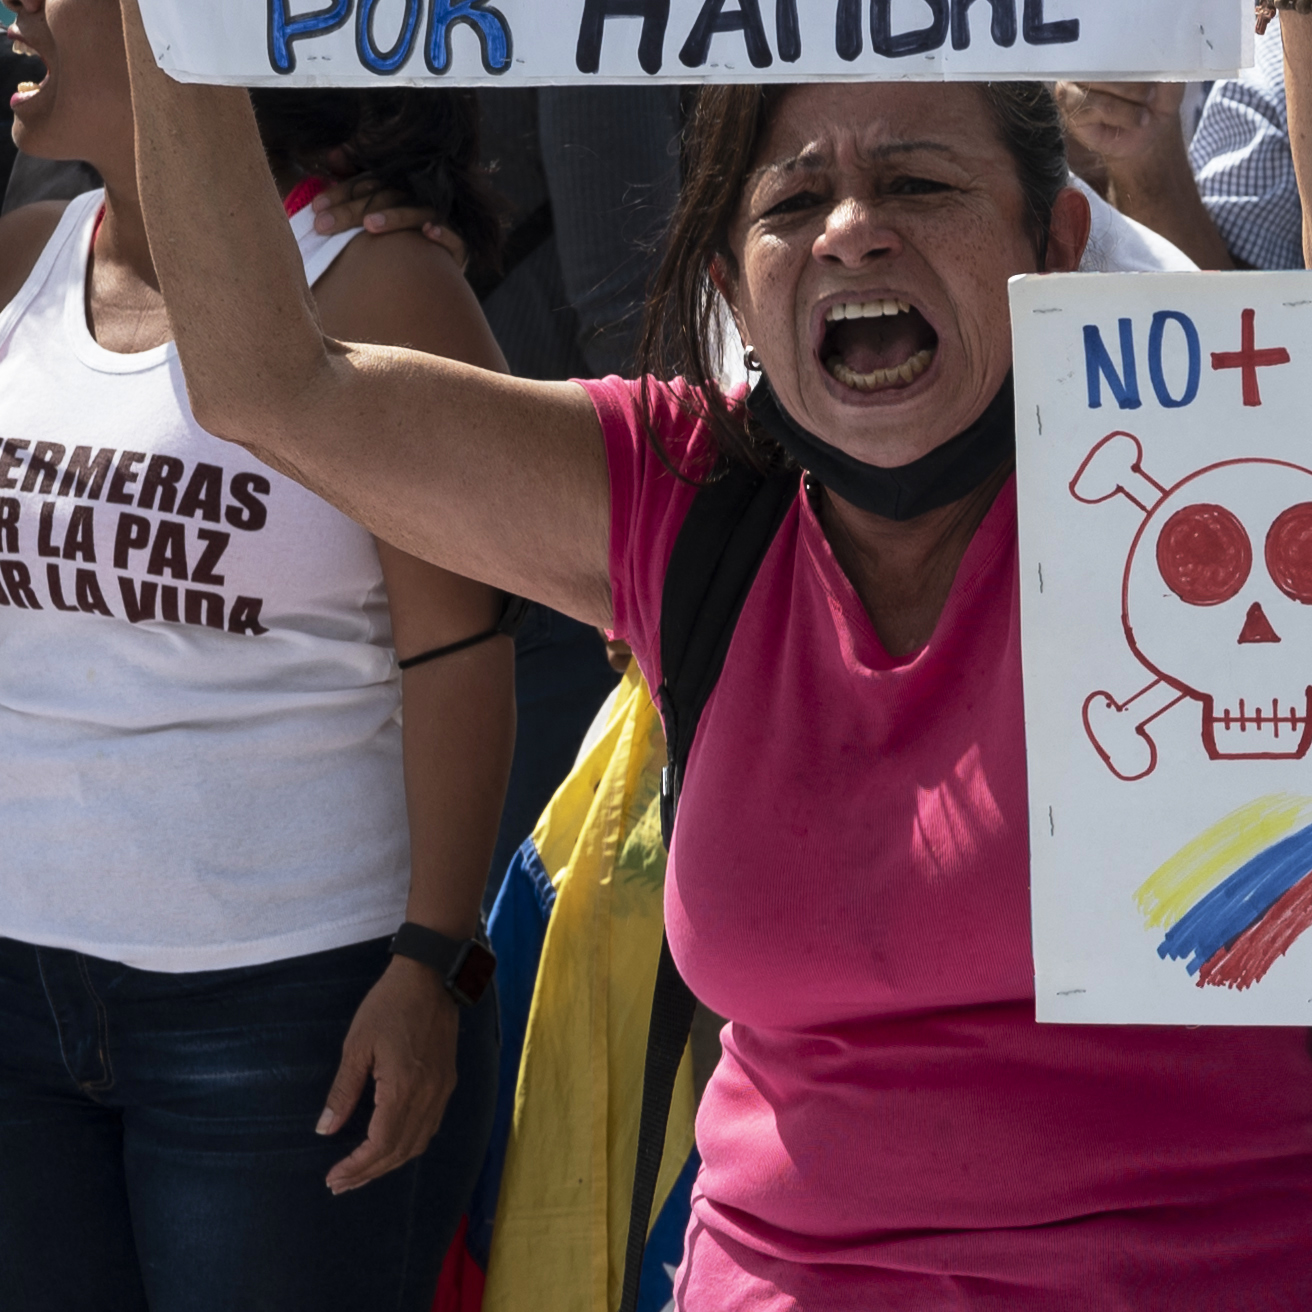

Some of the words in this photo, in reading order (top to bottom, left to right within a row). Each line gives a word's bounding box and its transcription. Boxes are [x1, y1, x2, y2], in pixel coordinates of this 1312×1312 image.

[0, 437, 271, 532] ERMERAS
[38, 501, 97, 563] LA
[113, 511, 231, 586] PAZ
[46, 562, 115, 618] LA
